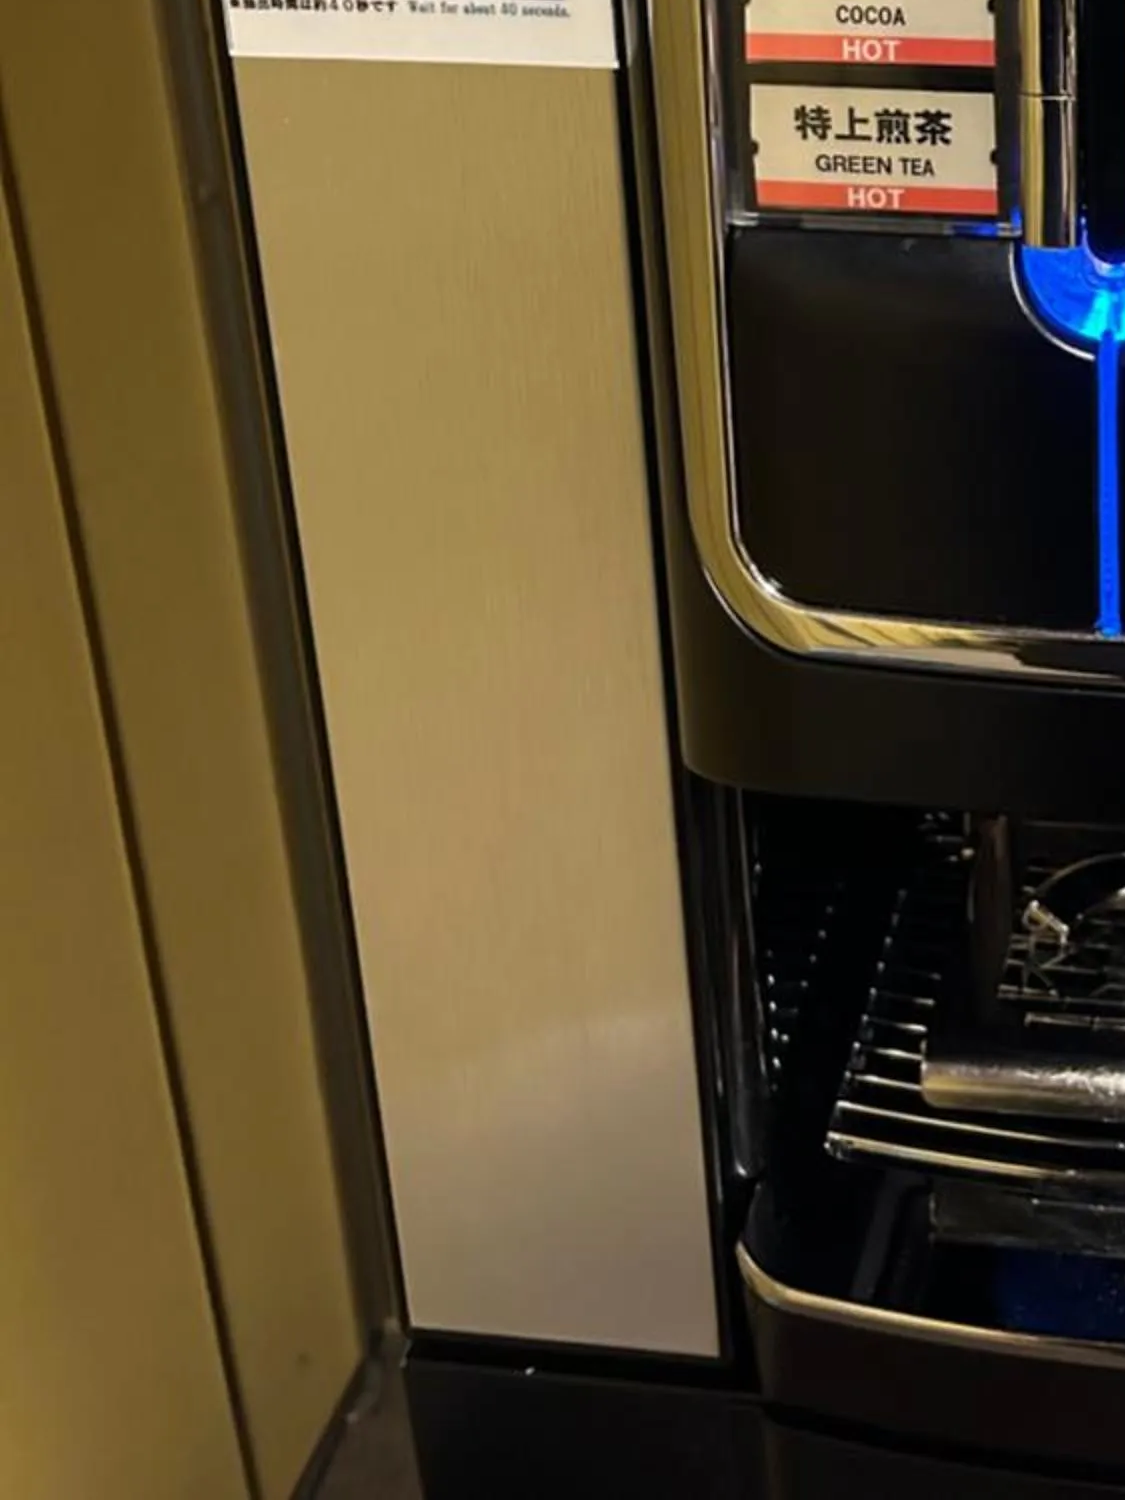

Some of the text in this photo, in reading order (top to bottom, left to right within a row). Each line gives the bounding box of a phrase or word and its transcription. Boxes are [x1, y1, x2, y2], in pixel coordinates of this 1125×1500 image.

[835, 5, 906, 26] COCOA
[842, 39, 901, 62] HOT
[794, 105, 952, 146] 特上煎茶
[815, 154, 935, 177] GREEN TEA
[847, 187, 904, 209] HOT
